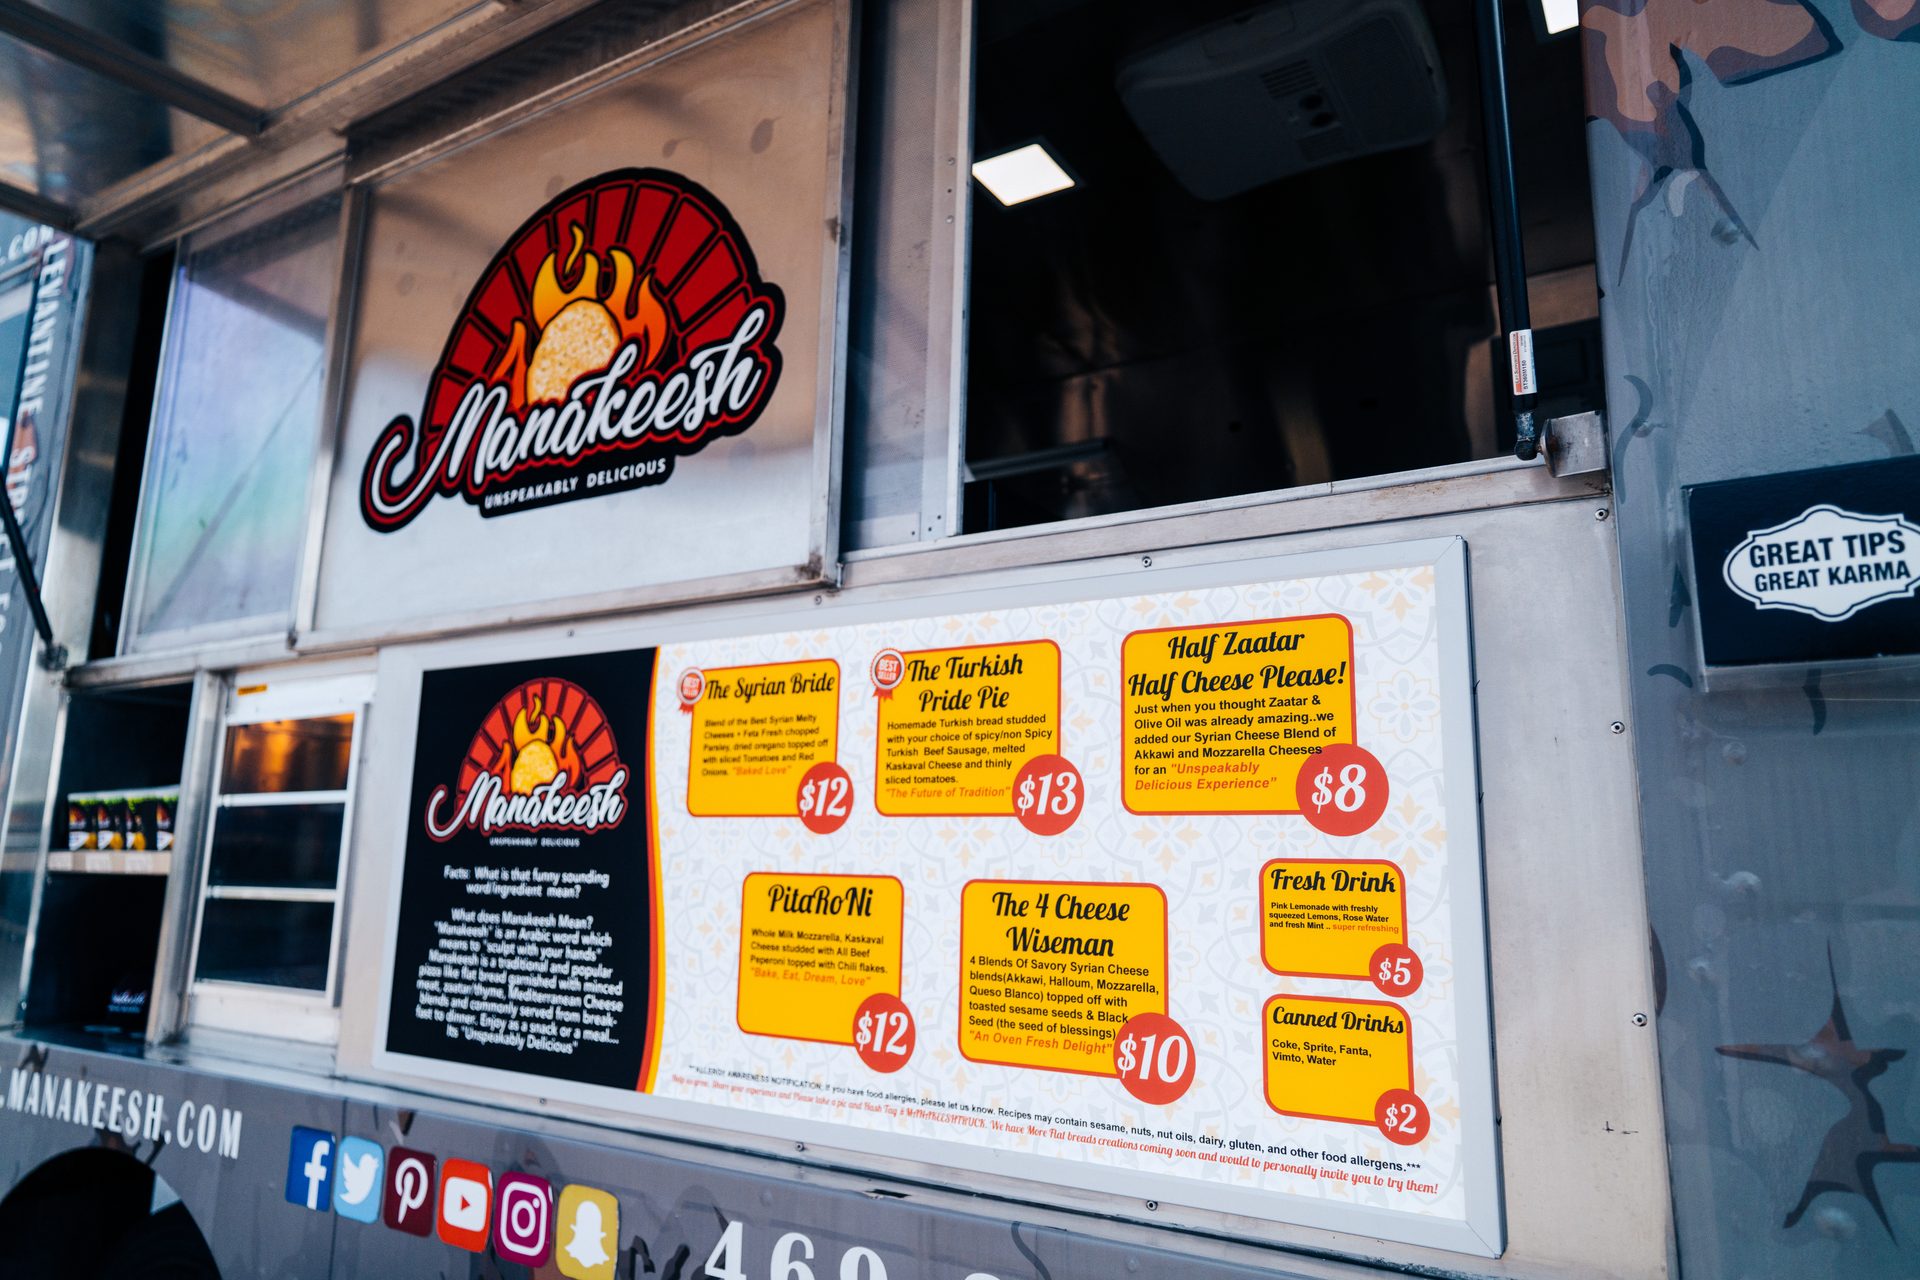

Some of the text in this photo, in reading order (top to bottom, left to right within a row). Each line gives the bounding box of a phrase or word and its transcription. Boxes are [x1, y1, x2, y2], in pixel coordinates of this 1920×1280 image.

[371, 307, 765, 514] Manakeesh
[484, 458, 666, 509] UNSPEAKABLY DELICIOUS
[1750, 530, 1905, 568] GREAT TIPS
[1755, 561, 1911, 592] GREAT KARMA
[1168, 630, 1305, 664] Half Zaatar
[879, 659, 898, 671] BEST
[907, 653, 1024, 682] The Turkish
[707, 680, 730, 700] The
[734, 677, 785, 703] Syrian
[791, 672, 835, 694] Bride
[1129, 661, 1347, 701] Half Cheese Please!
[919, 685, 1010, 712] Pride Pie
[1134, 695, 1321, 714] Just when you thought Zaatar &
[887, 714, 1046, 730] Homemade Turkish bread studded
[1134, 711, 1334, 729] Olive Oil was already amazing..we
[887, 728, 1052, 744] with your choice of spicy/non Spicy
[1134, 726, 1337, 745] added our Syrian Cheese Blend of
[887, 744, 1025, 757] Turkish Beef Sausage, melted
[1134, 744, 1323, 760] Akkawi and Mozzarella Cheeses
[886, 759, 1012, 771] Kaskaval Cheese and thinly
[1134, 762, 1260, 775] for an "Unspeakably
[886, 775, 958, 784] sliced tomatoes.
[1134, 777, 1277, 791] Delicious Experience"
[1311, 764, 1367, 813] $8
[428, 769, 626, 837] Manakeesh
[800, 777, 848, 817] $12
[1017, 772, 1077, 816] $13
[1270, 869, 1396, 893] Fresh Drink
[992, 891, 1130, 922] The 4 Cheese
[1290, 903, 1330, 911] Lemonade
[1351, 905, 1378, 914] freshly
[1307, 913, 1341, 921] Lemons,
[1343, 914, 1364, 922] Rose
[451, 908, 594, 930] What does Manakeesh Mean?
[1357, 925, 1399, 934] refreshing
[751, 928, 884, 944] Whole Milk Mozzarella, Kaskaval
[1006, 927, 1114, 957] Wiseman
[970, 956, 1149, 977] 4 Blends Of Savory Syrian Cheese
[1379, 957, 1411, 986] $5
[970, 971, 1159, 995] blends(Akkawi, Halloum, Mozzarella,
[970, 986, 1128, 1007] Queso Blanco) topped off with
[969, 1001, 1129, 1024] toasted sesame seeds & Black
[1273, 1006, 1404, 1034] Canned Drinks
[856, 1011, 908, 1056] $12
[1118, 1033, 1188, 1083] $10
[1272, 1039, 1372, 1057] Coke, Sprite, Fanta,
[1272, 1052, 1337, 1066] Vimto, Water
[1385, 1103, 1417, 1134] $2
[998, 1108, 1037, 1121] Recipes
[1034, 1113, 1052, 1124] may
[1054, 1116, 1088, 1128] contain
[1090, 1121, 1129, 1134] sesame,
[1131, 1127, 1155, 1138] nuts,
[1157, 1130, 1173, 1140] nut
[1176, 1132, 1196, 1143] oils,
[1199, 1135, 1226, 1149] dairy,
[1229, 1139, 1264, 1155] gluten,
[1268, 1145, 1288, 1155] and
[1290, 1148, 1319, 1160] other
[1322, 1151, 1347, 1163] food
